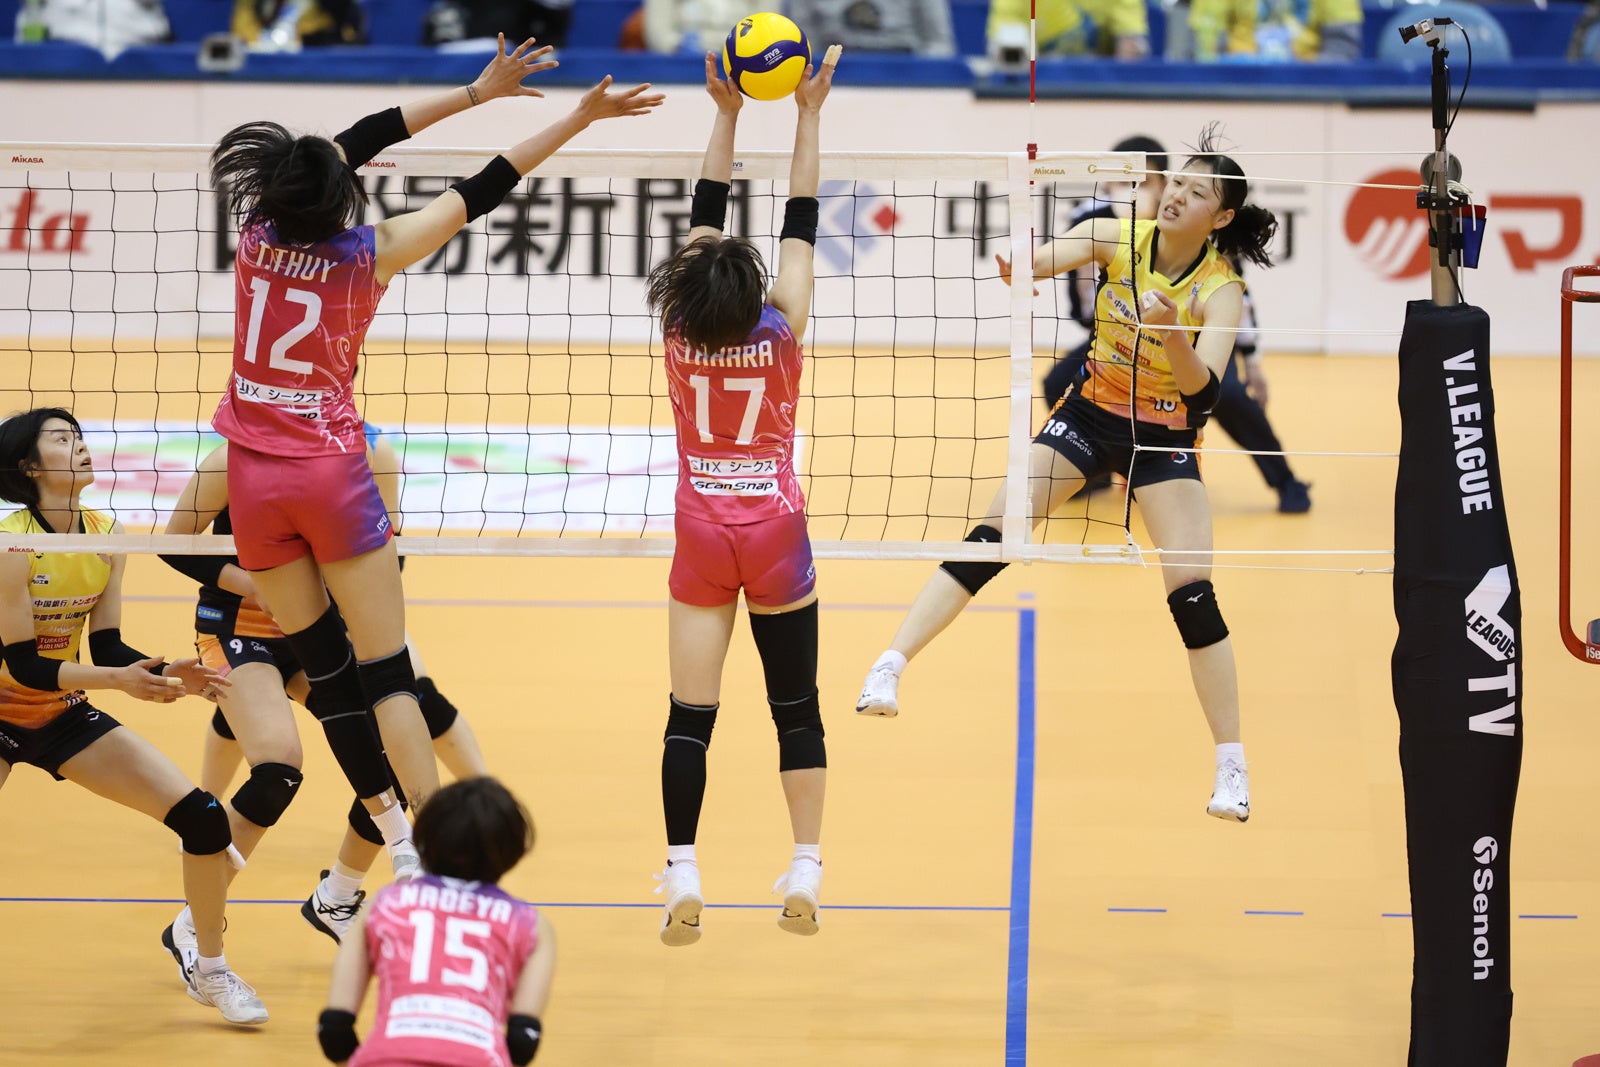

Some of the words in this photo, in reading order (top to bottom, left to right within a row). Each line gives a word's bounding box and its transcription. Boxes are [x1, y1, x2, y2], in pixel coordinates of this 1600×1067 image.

[763, 47, 781, 62] FIVB
[0, 187, 91, 255] ta
[1487, 193, 1600, 275] マ
[255, 240, 338, 283] T.THUY
[244, 275, 323, 375] 12
[1117, 344, 1149, 366] TURSH
[268, 388, 318, 403] シークス
[689, 374, 767, 446] 17
[1042, 418, 1068, 437] 18
[1442, 348, 1494, 515] V.LEAGUE
[729, 459, 774, 473] シークス
[229, 638, 244, 655] 9
[1465, 608, 1516, 660] LEAGUE
[1467, 661, 1516, 737] TV
[408, 909, 491, 993] 15
[1472, 867, 1495, 981] Senoh
